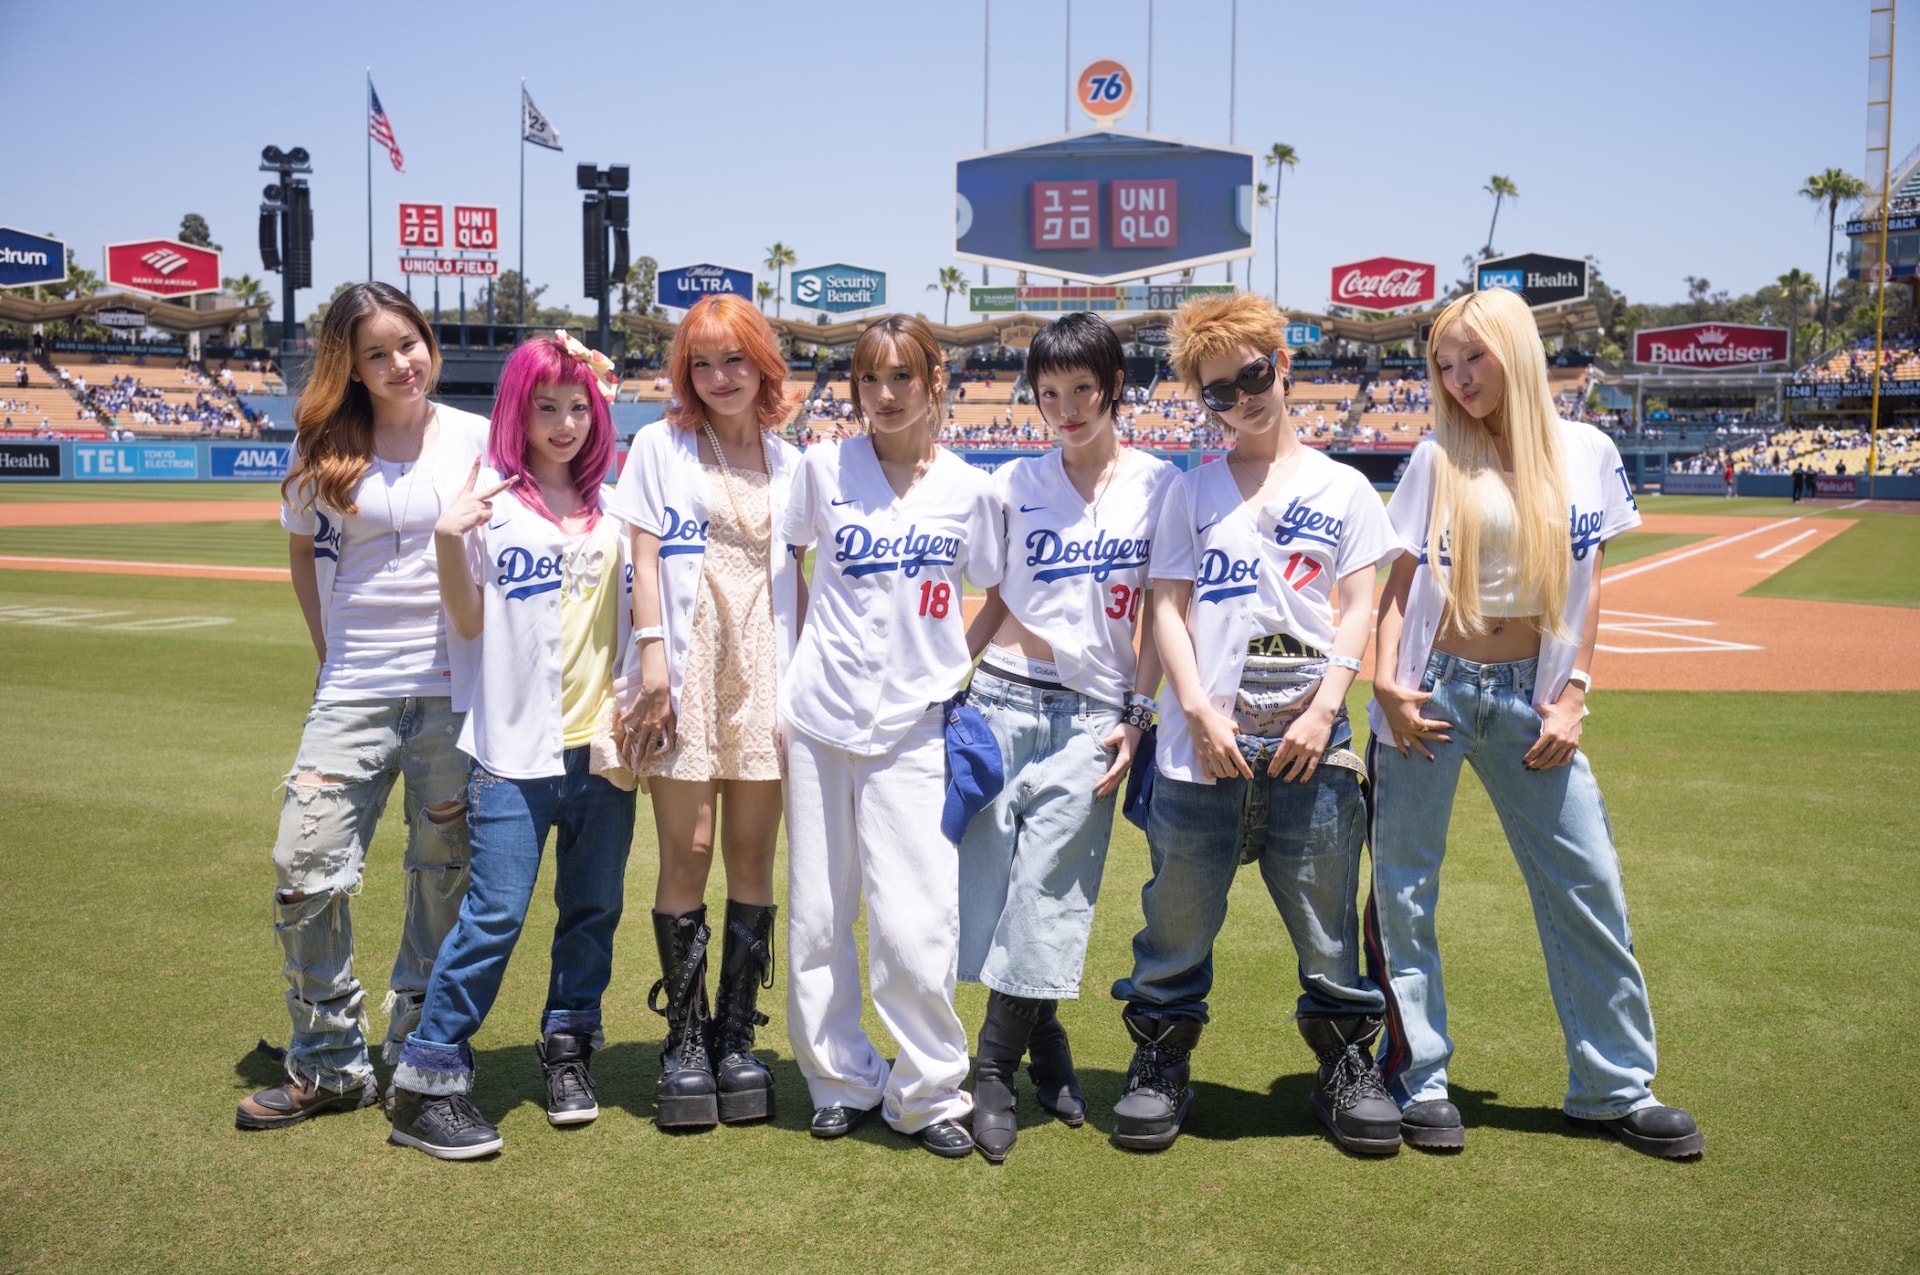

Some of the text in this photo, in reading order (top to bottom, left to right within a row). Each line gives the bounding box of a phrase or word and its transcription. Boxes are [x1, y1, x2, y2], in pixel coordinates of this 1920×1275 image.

[1088, 72, 1124, 102] 76
[1120, 188, 1165, 211] UNI
[458, 211, 490, 228] UNI
[459, 228, 493, 246] QLO
[1120, 215, 1170, 243] QLO
[404, 259, 495, 274] UNIQLO FIELD
[132, 276, 198, 287] BANK OF AMERICA
[677, 277, 733, 291] ULTRA
[826, 274, 879, 290] Security
[1338, 268, 1427, 298] Coca-Cola
[1483, 272, 1578, 288] UCLA Health
[827, 289, 872, 303] Benefit
[1282, 326, 1316, 343] TEL
[1649, 342, 1771, 363] Budweiser
[77, 449, 134, 473] TEL
[143, 450, 176, 458] TOKYO
[234, 450, 278, 468] ANA
[144, 459, 194, 468] ELECTRON
[1816, 479, 1855, 493] Yakult
[835, 524, 959, 578] Dodgers
[1025, 529, 1151, 583] Dodgers
[1283, 551, 1323, 592] 17
[919, 579, 951, 619] 18
